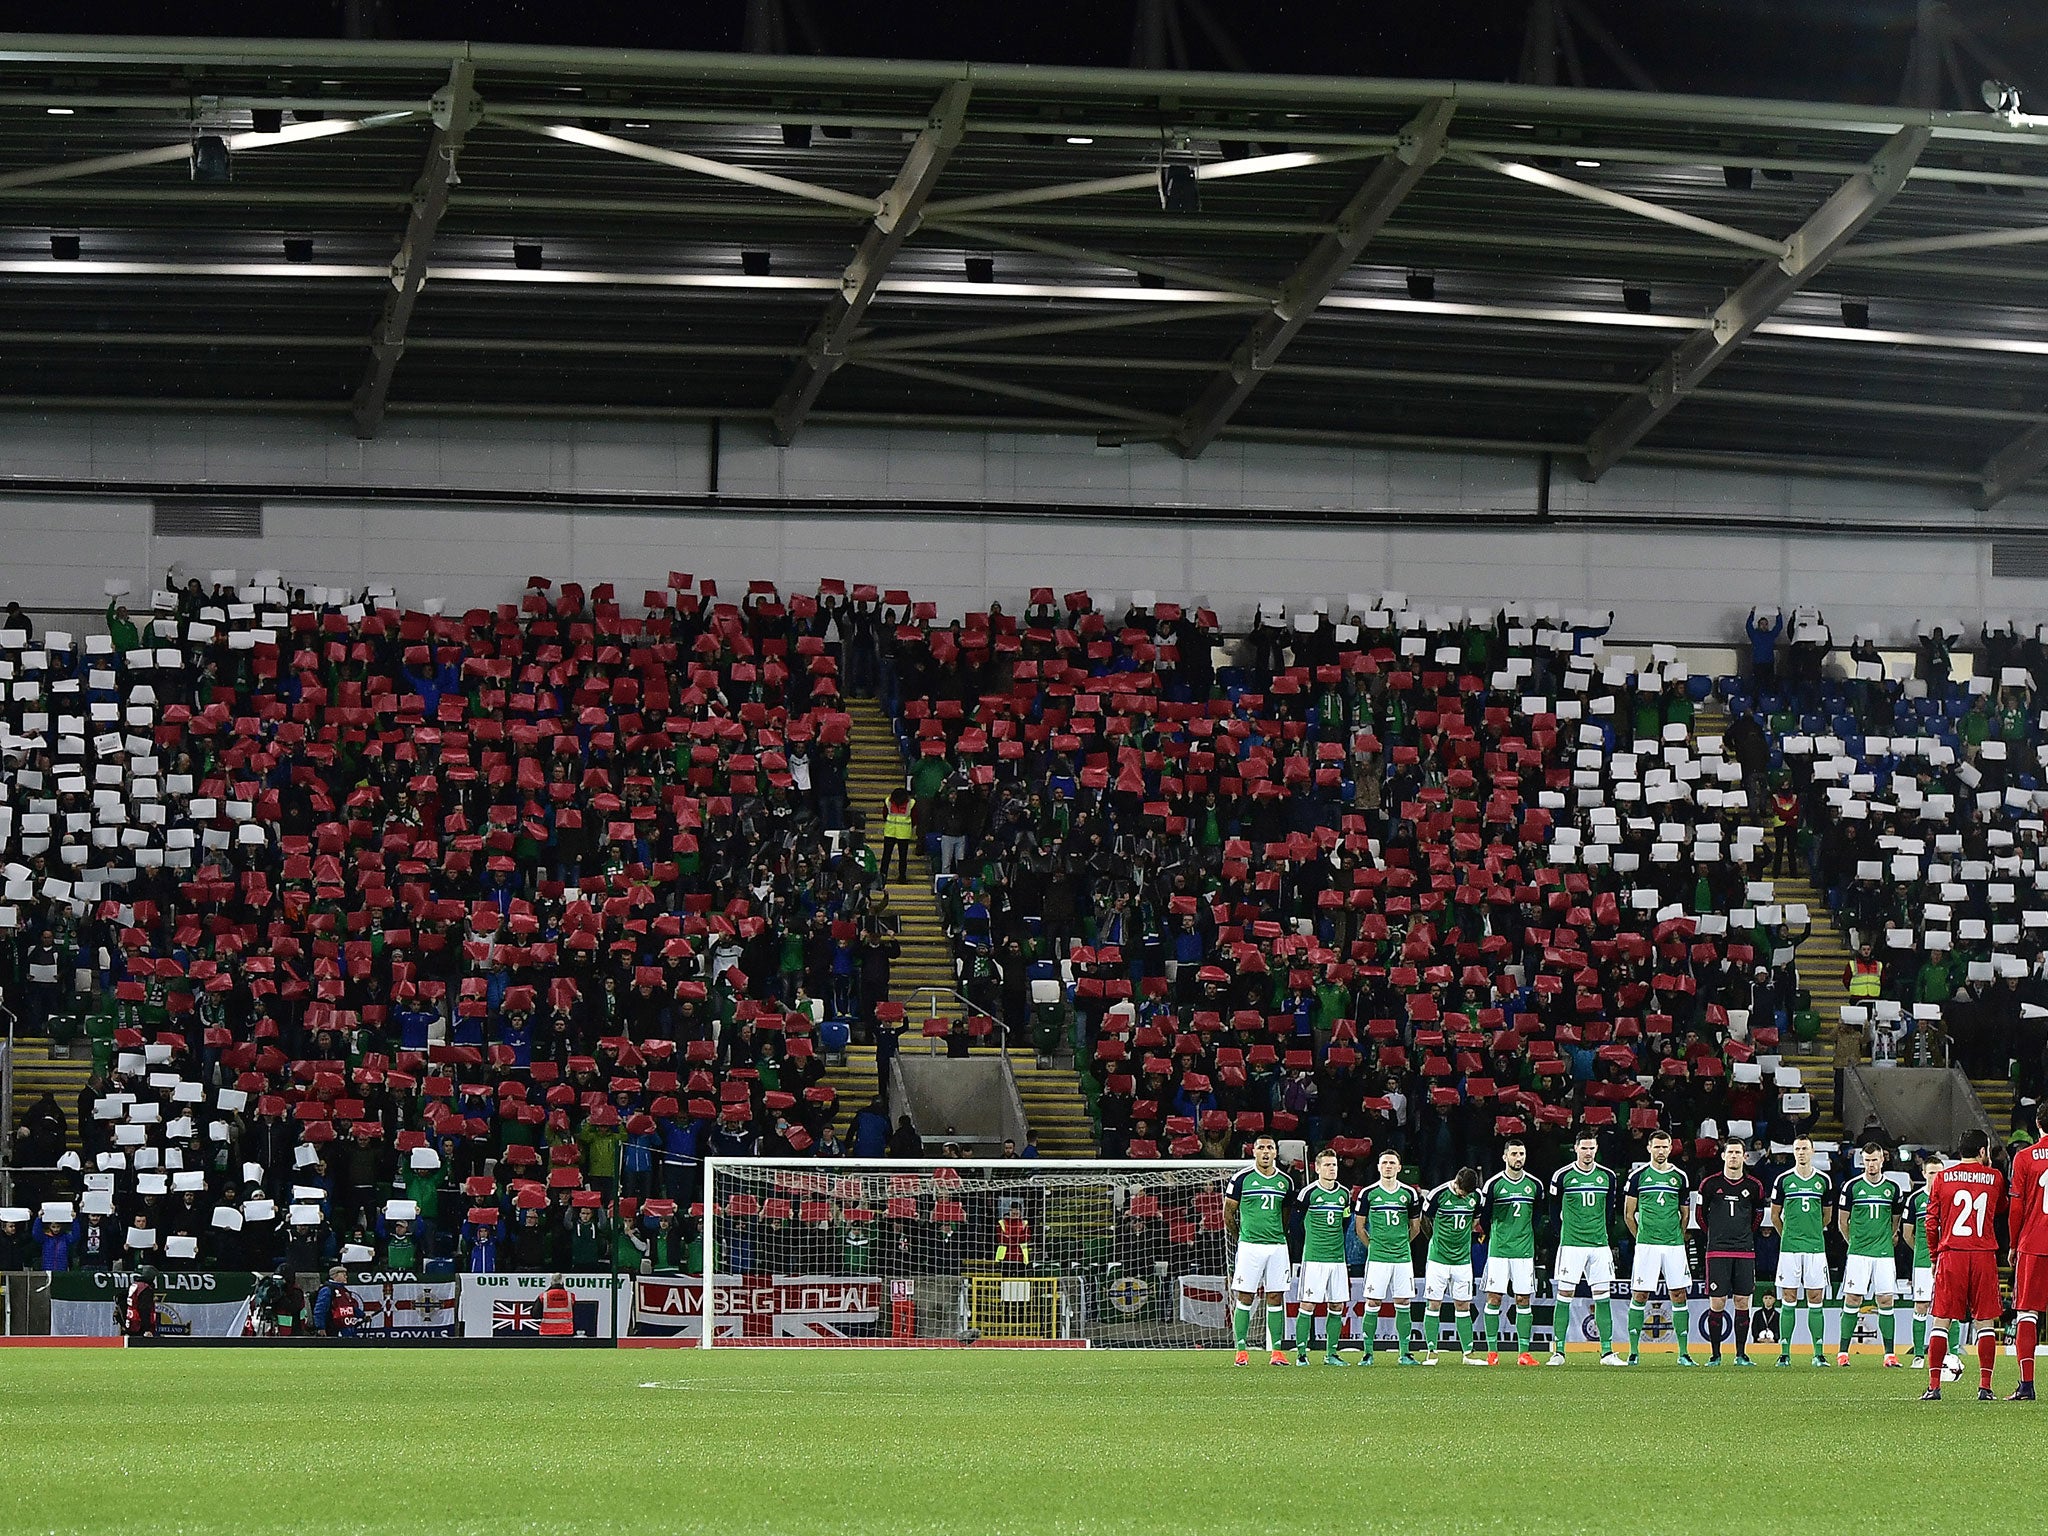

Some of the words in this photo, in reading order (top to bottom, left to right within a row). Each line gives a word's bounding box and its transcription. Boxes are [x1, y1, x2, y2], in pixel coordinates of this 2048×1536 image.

[1943, 1171, 1995, 1185] DASHDEMIROV
[1260, 1195, 1275, 1210] 21
[1581, 1191, 1596, 1207] 10
[1656, 1191, 1665, 1206] 4
[1801, 1198, 1810, 1213] 5
[1513, 1202, 1521, 1217] 2
[1729, 1200, 1735, 1217] 1
[1869, 1203, 1880, 1219] 11
[1952, 1189, 1988, 1238] 21
[1326, 1211, 1335, 1225] 8
[1385, 1210, 1400, 1226] 13
[1454, 1214, 1466, 1230] 16
[93, 1272, 158, 1289] C'MO
[163, 1273, 216, 1290] LADS
[357, 1272, 418, 1283] GAWA
[476, 1276, 509, 1287] OUR
[517, 1276, 546, 1288] WEE
[563, 1277, 625, 1290] OUNTRY
[640, 1284, 775, 1314] LAMBEG
[781, 1286, 880, 1314] LOYAL
